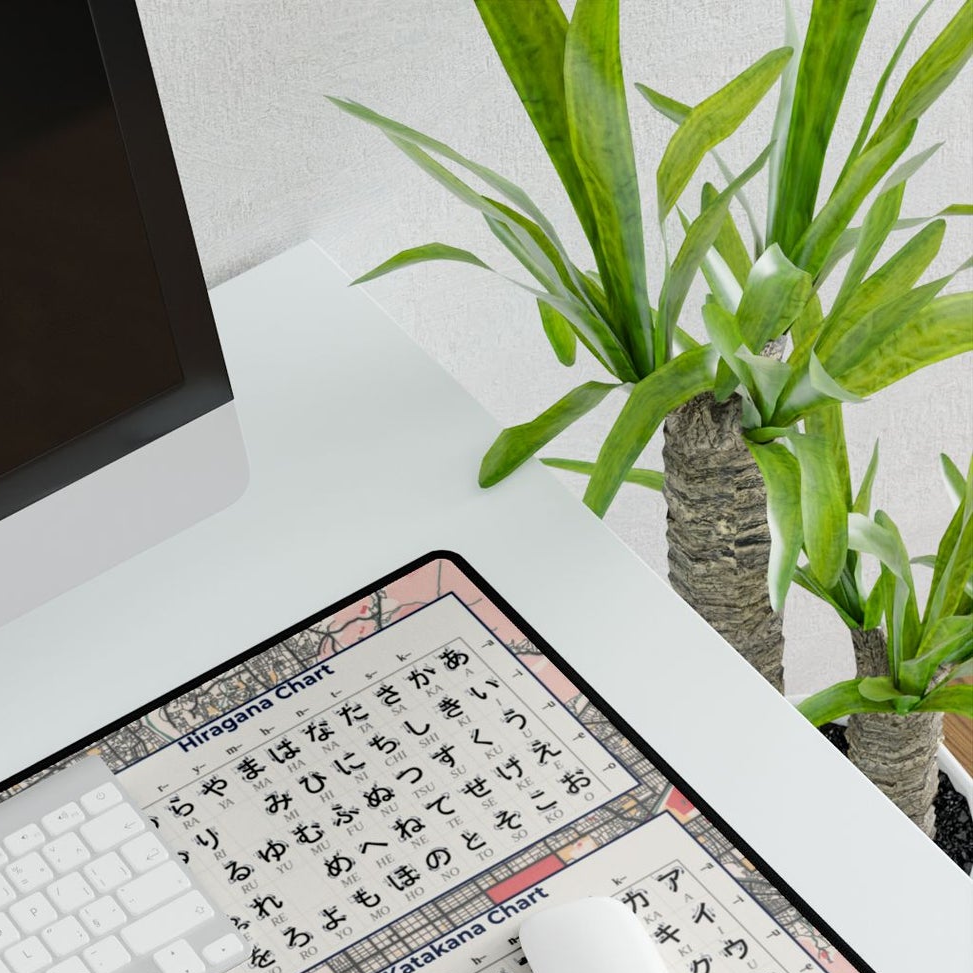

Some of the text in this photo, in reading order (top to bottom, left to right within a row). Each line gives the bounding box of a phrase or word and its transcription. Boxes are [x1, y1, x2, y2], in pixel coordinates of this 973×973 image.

[169, 649, 469, 817] ら や ま は な た さ か あ
[177, 664, 335, 752] Hiragana Chart
[182, 684, 444, 830] RA YA MA HA NA TA SA KA
[196, 680, 499, 850] り み ひ に ち し き い
[224, 709, 527, 881] る ゆ む ふ ぬ つ す く う
[251, 771, 591, 969] を ろ よ も ほ の と そ こ お
[252, 741, 562, 917] れ め へ ね て せ け え
[30, 907, 38, 917] P
[299, 946, 319, 961] RO
[335, 926, 353, 940] YO
[370, 905, 391, 922] MO
[405, 886, 425, 903] HO
[441, 866, 461, 882] NO
[477, 848, 495, 862] TO
[511, 829, 529, 843] SO
[545, 809, 565, 824] KO
[487, 886, 550, 925] Chart
[642, 910, 664, 926] KA
[655, 925, 680, 944] キ
[694, 902, 714, 924] イ
[657, 869, 679, 893] ア
[22, 950, 33, 959] L
[724, 939, 748, 960] ウ
